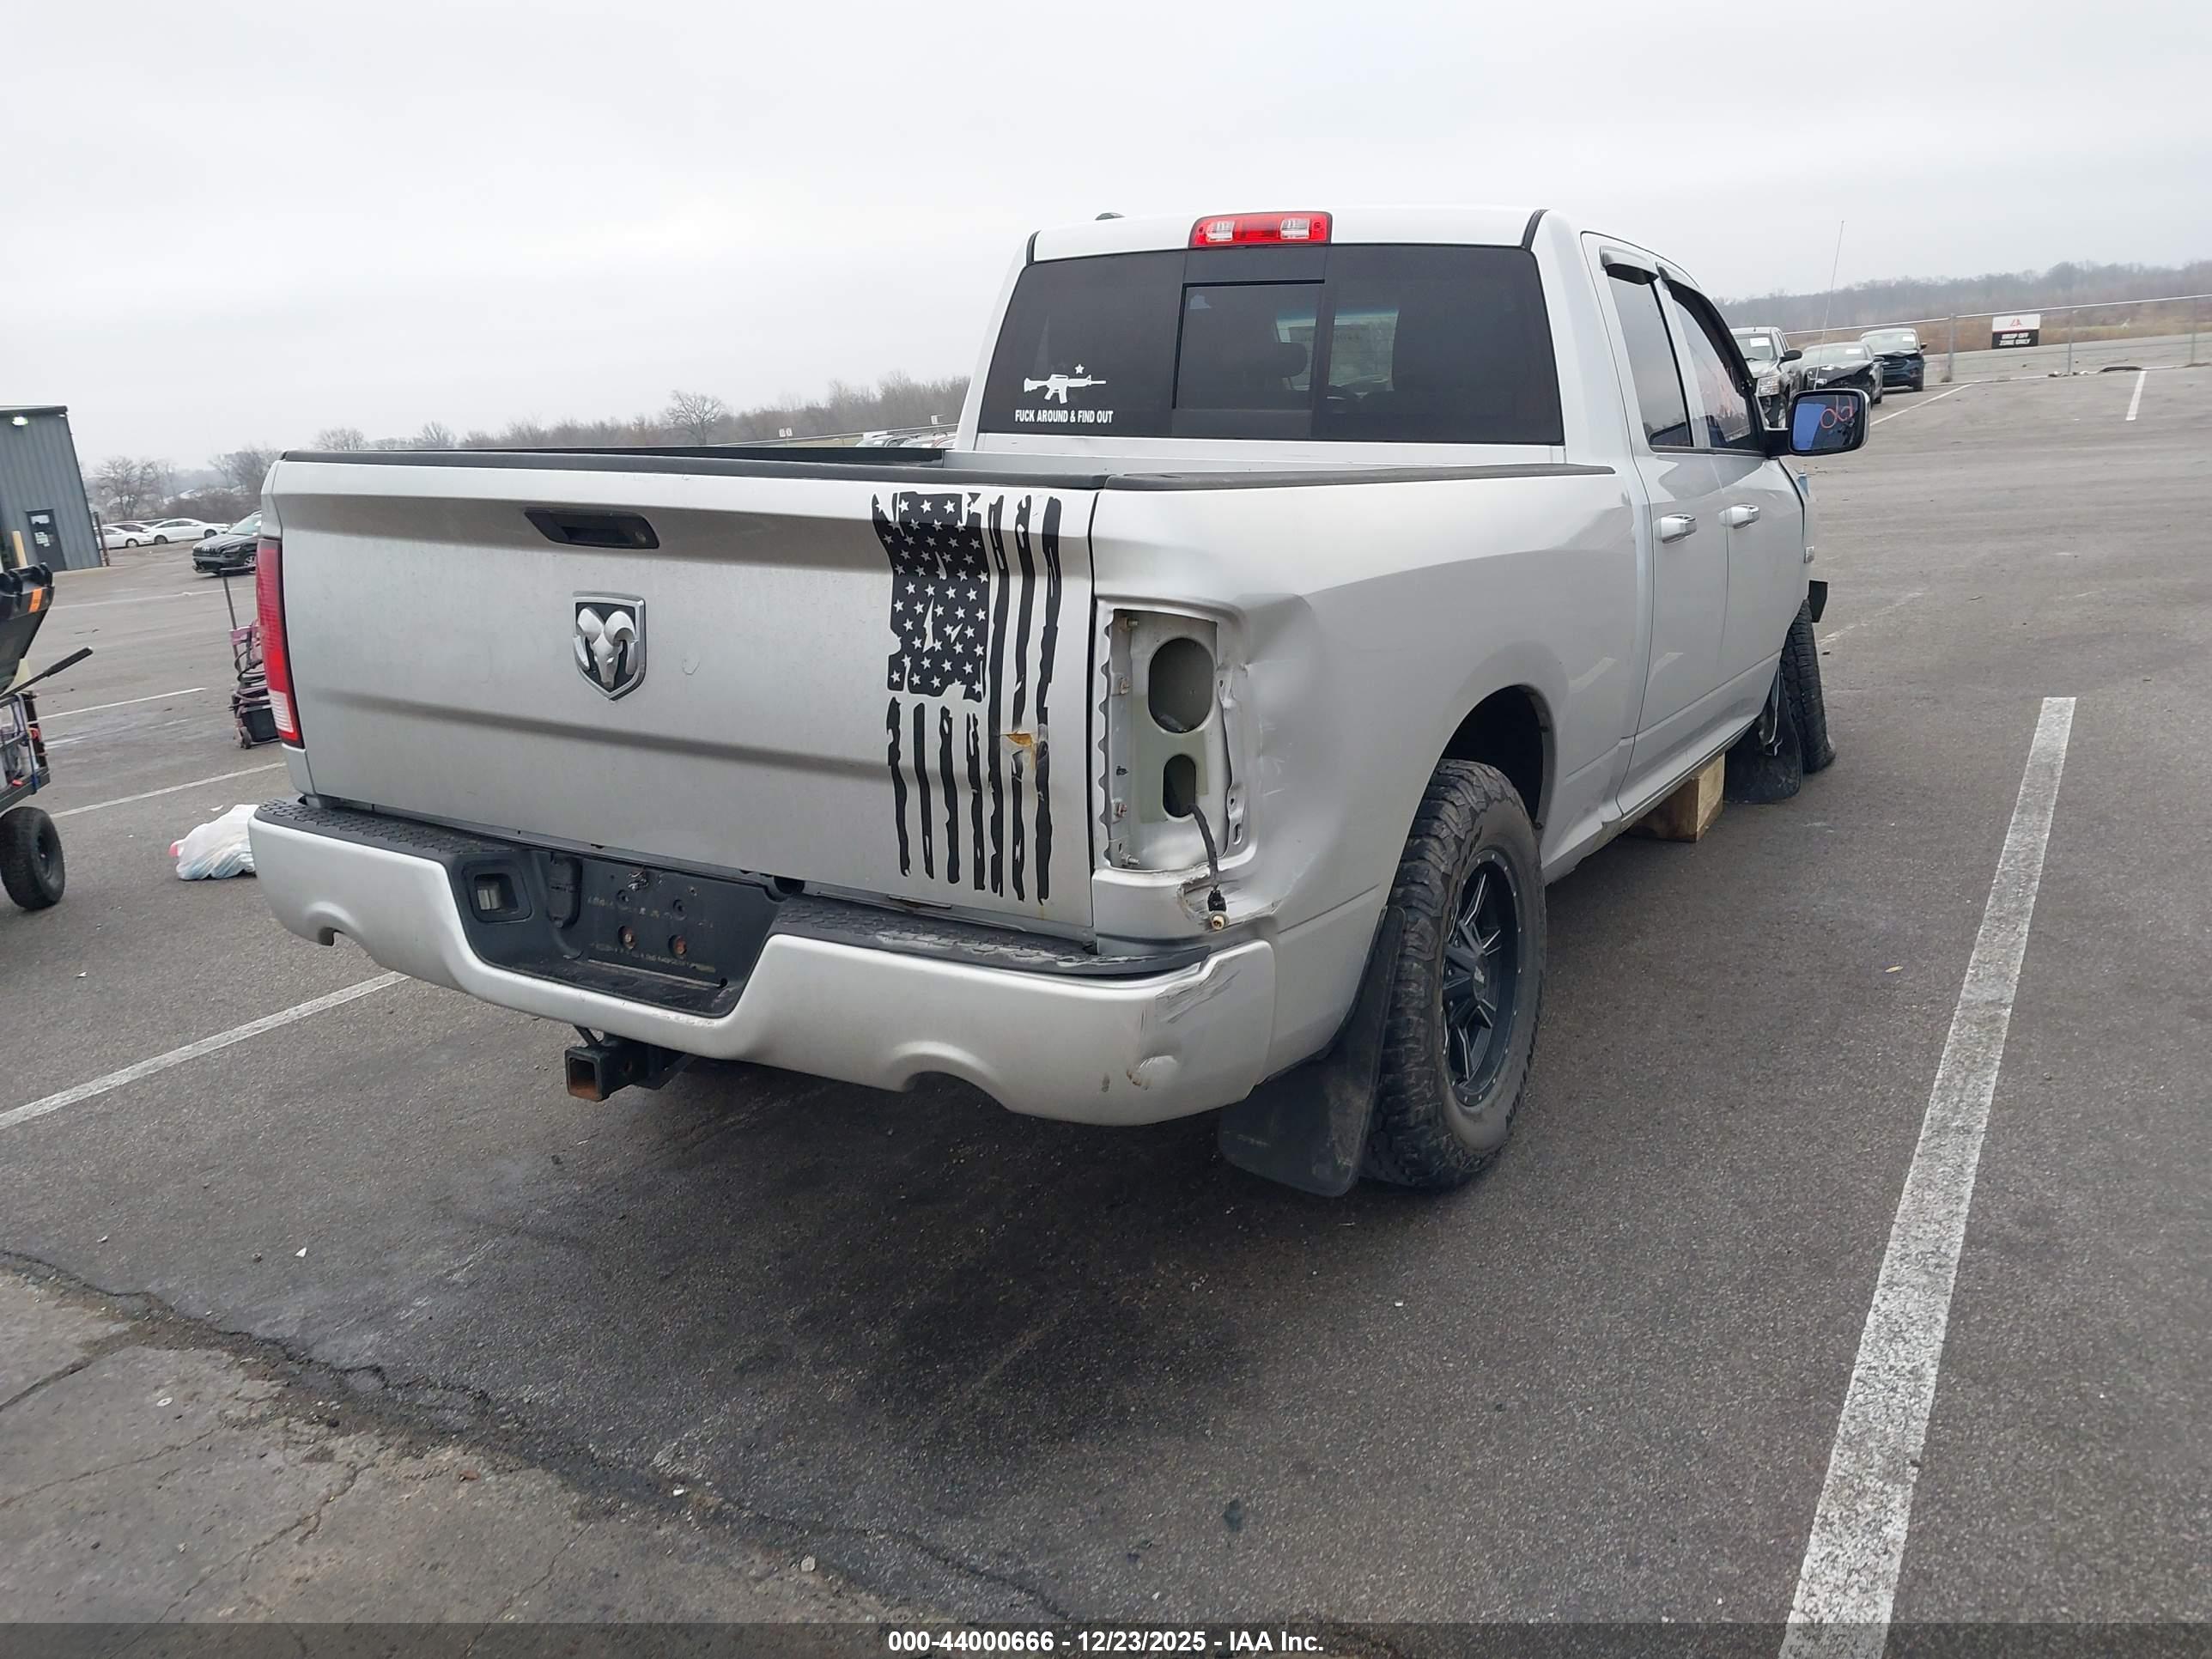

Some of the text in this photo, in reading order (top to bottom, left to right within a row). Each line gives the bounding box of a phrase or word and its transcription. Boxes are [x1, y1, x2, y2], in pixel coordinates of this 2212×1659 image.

[1015, 410, 1114, 423] FUCK AROUND & FIND OUT
